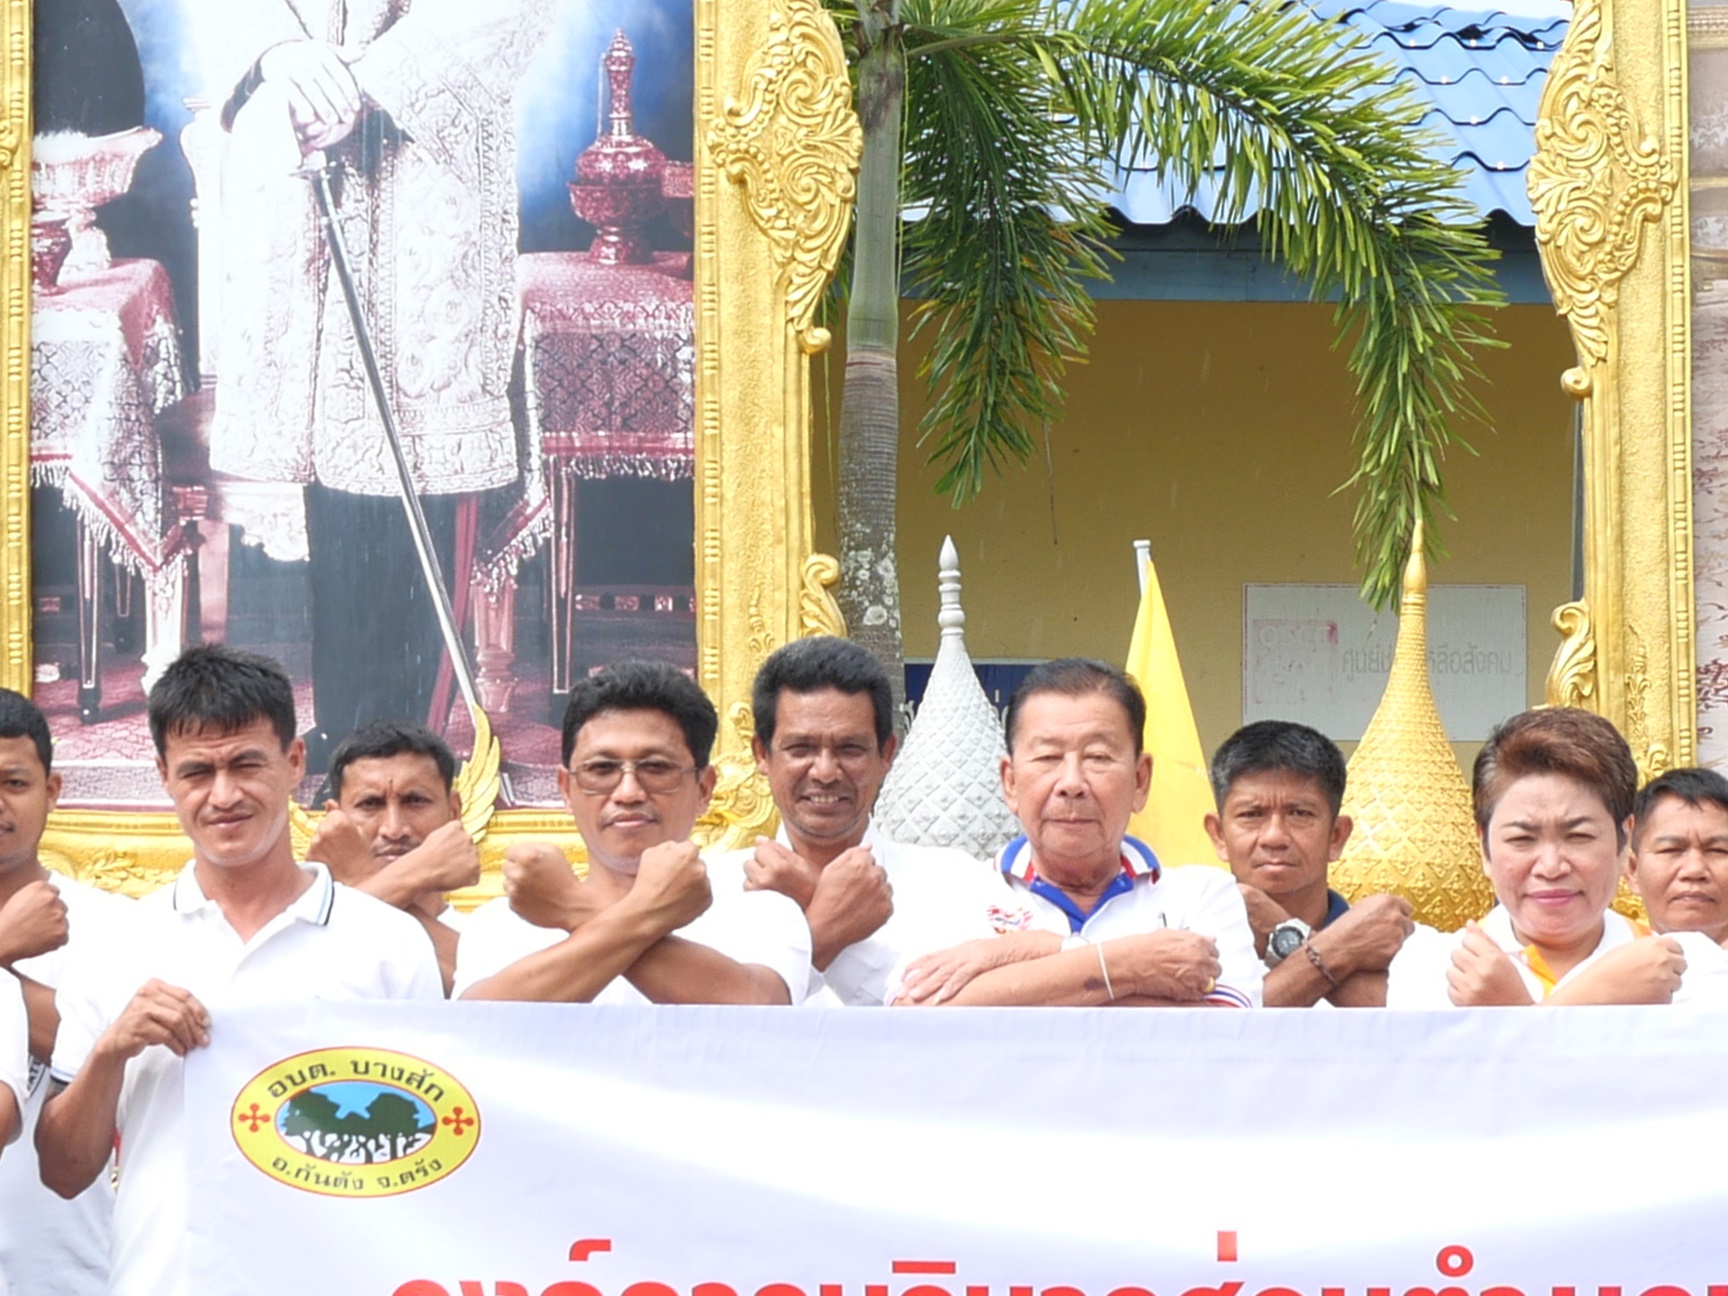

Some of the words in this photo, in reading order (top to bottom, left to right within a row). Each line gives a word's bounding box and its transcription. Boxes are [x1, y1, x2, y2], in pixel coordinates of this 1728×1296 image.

[267, 1062, 336, 1098] อบต.
[350, 1059, 445, 1102] บางสัก
[273, 1157, 365, 1190] อ.กันตัง
[377, 1157, 443, 1189] จ.ตรัง
